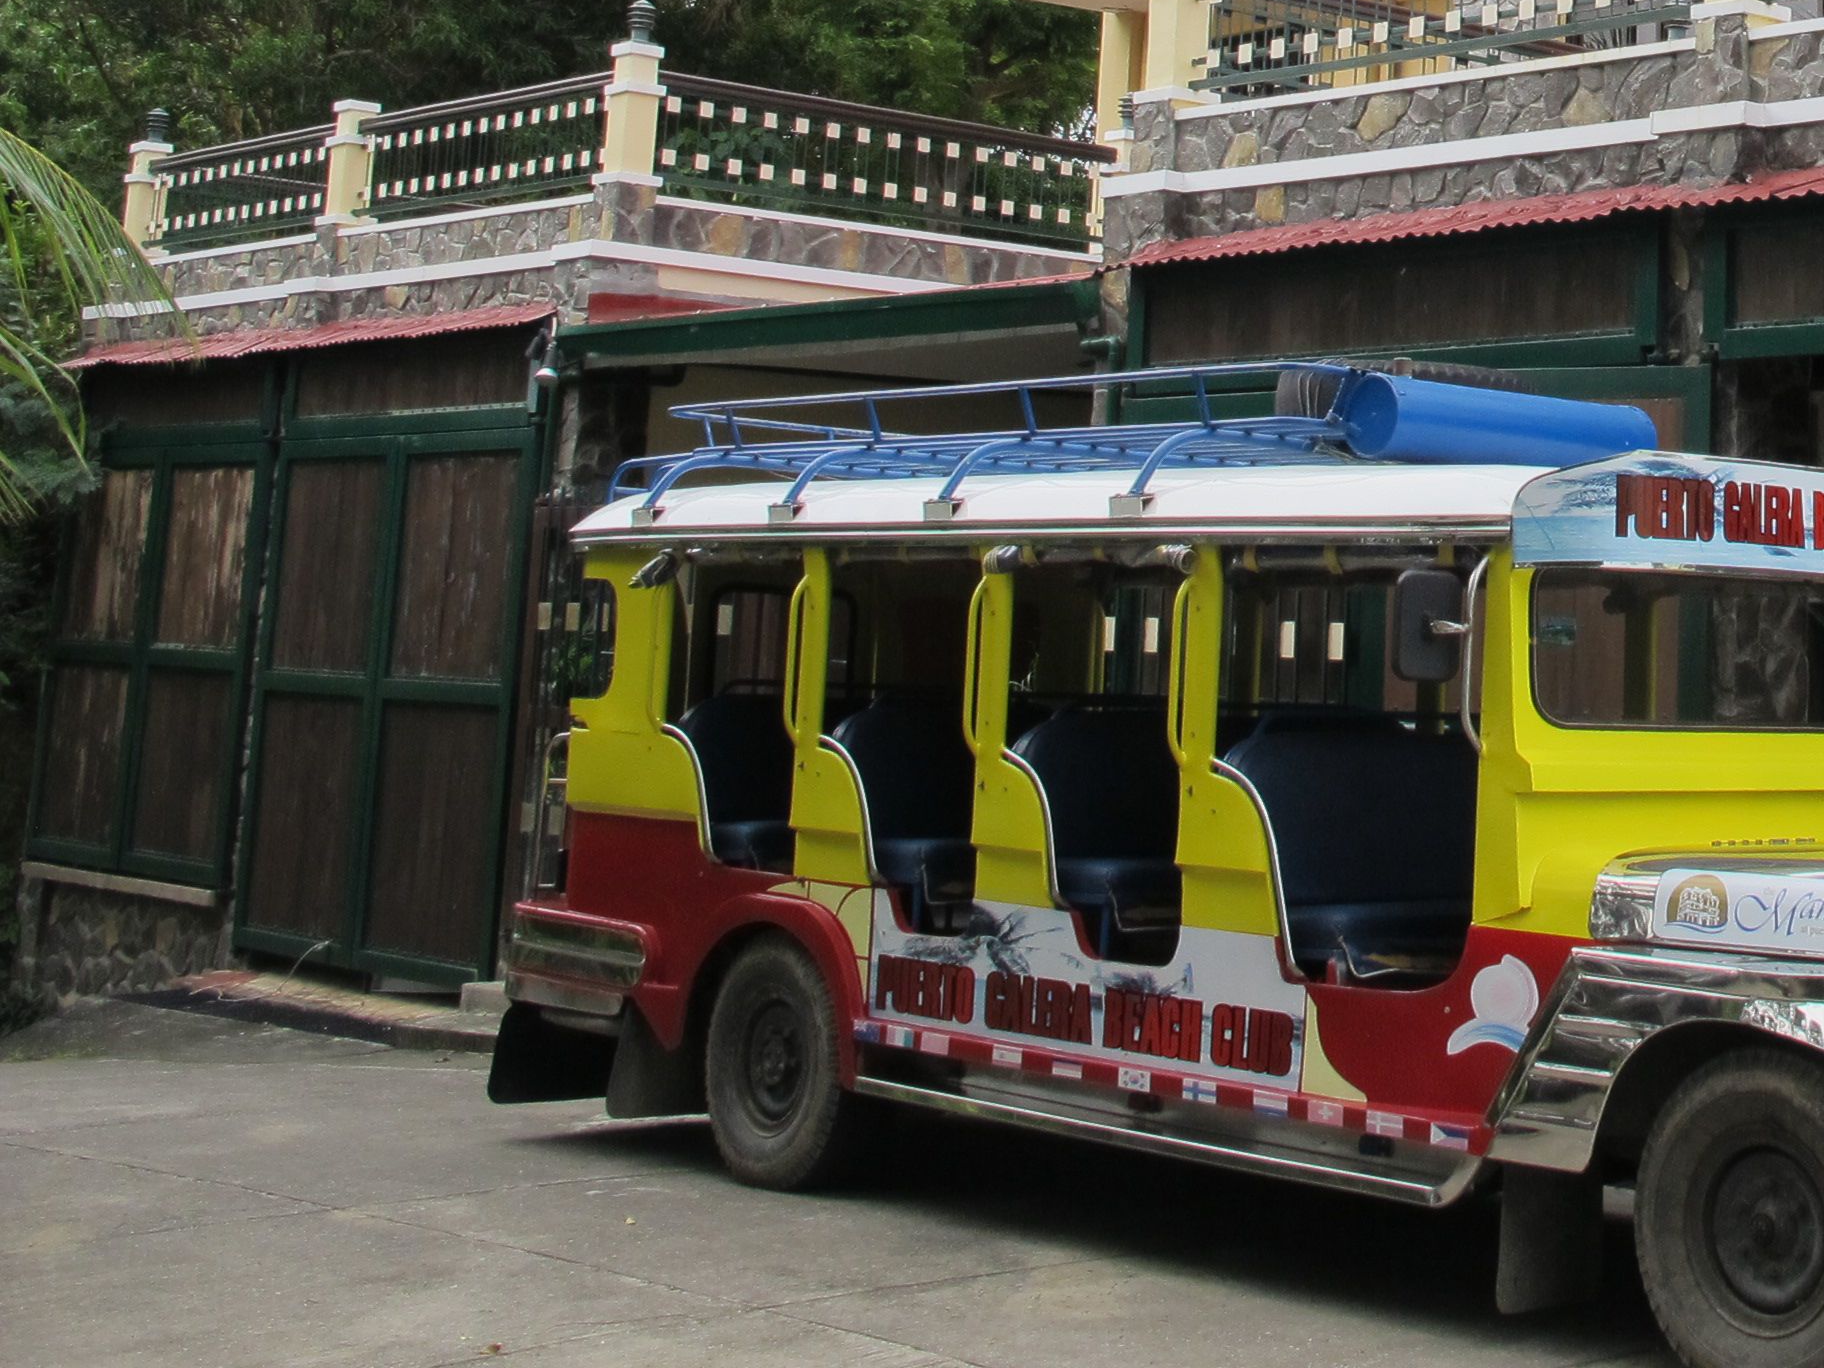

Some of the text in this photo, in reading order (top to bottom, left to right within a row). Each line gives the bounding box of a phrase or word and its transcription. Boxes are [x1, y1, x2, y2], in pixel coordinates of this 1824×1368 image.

[1615, 474, 1715, 543] PUERTO
[1724, 480, 1806, 550] GALERA
[876, 953, 1294, 1076] PUERTO GALERA BEACH CLUB
